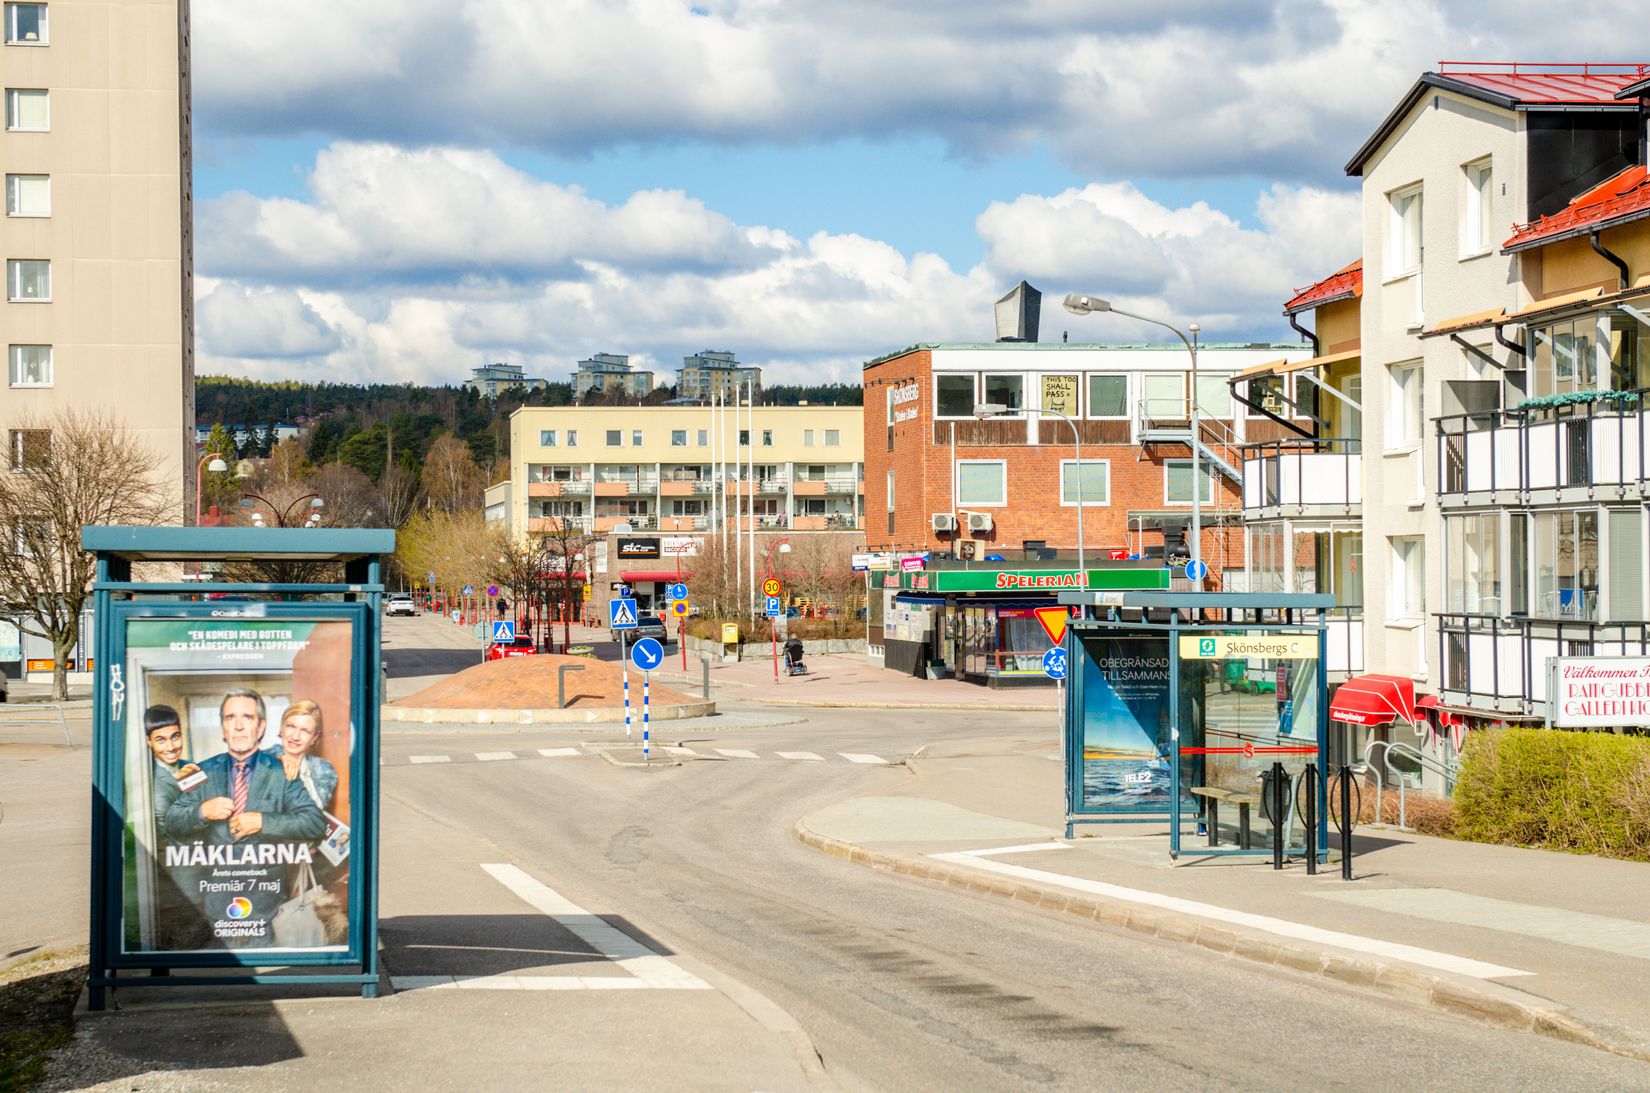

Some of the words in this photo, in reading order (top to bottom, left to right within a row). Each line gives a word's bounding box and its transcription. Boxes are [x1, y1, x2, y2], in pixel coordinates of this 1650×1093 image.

[1045, 390, 1065, 398] PASS
[766, 582, 779, 592] 30
[769, 599, 777, 609] P
[205, 630, 238, 640] KOMEDI
[239, 630, 258, 639] MED
[259, 629, 293, 639] BOTTEN
[169, 641, 188, 651] OCH
[189, 640, 255, 651] SKÅDESPELARE
[1226, 641, 1288, 656] Skönsbergs
[1290, 642, 1299, 653] C
[1563, 665, 1638, 679] Välkommen
[1564, 700, 1626, 717] GALLERI
[1125, 771, 1152, 783] TELE2
[165, 841, 313, 867] MÄKLARNA
[212, 868, 231, 877] Årets
[231, 868, 268, 877] comeback
[199, 879, 245, 893] Premiär
[247, 879, 257, 892] 7
[258, 879, 281, 894] maj
[214, 918, 266, 929] discovery+
[214, 927, 266, 938] ORIGINALS
